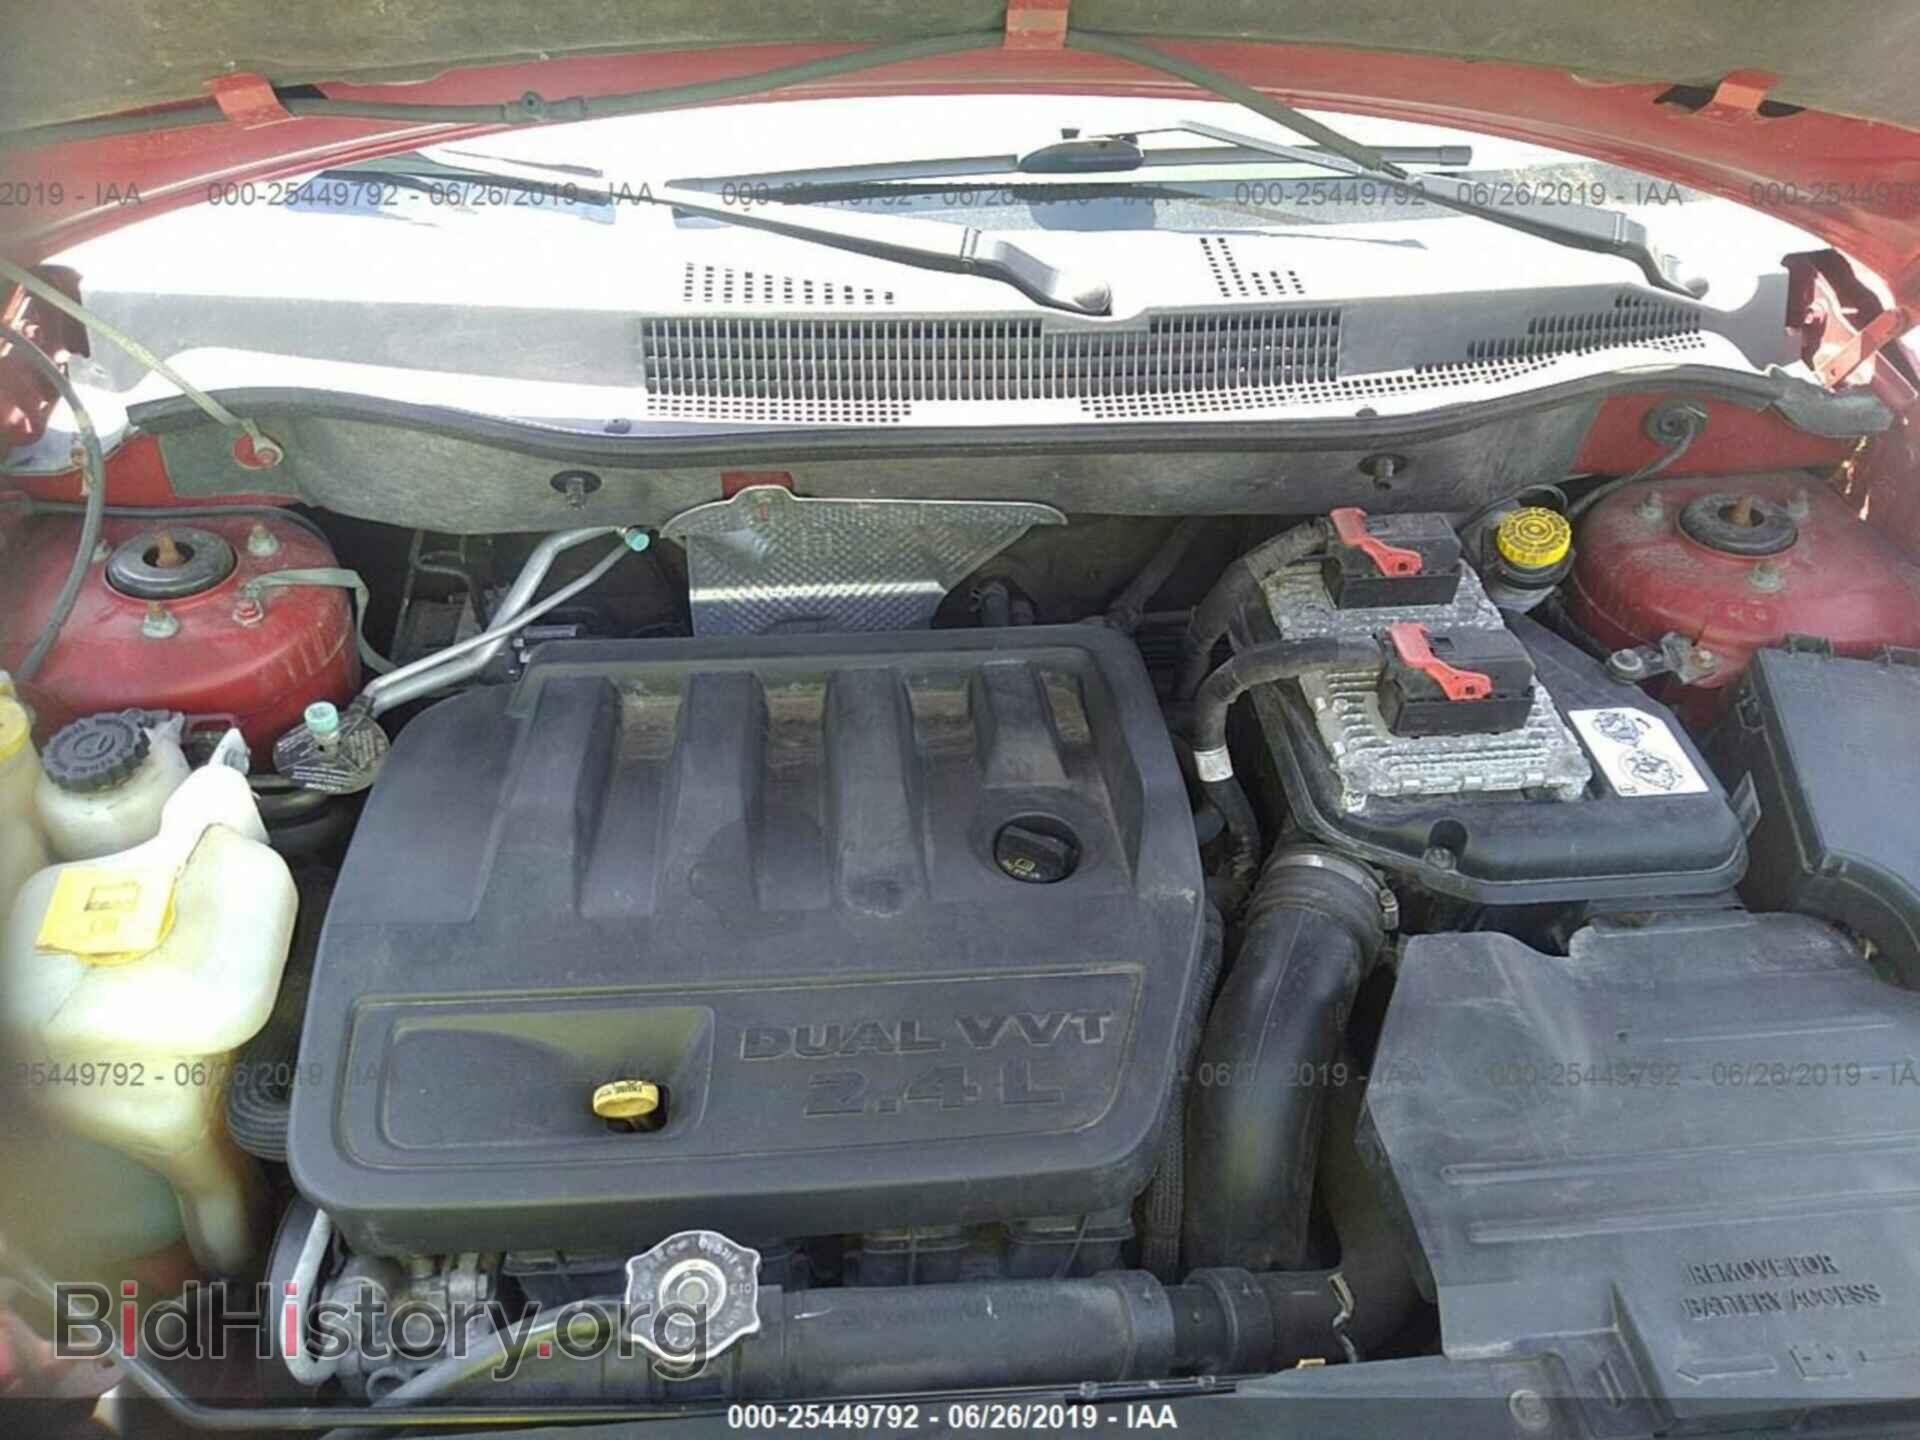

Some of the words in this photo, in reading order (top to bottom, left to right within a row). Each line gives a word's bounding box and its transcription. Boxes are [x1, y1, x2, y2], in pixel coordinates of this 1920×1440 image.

[740, 1019, 947, 1061] DUAL
[955, 1010, 1118, 1050] VVT
[802, 1057, 1066, 1119] 2.4L
[1688, 1255, 1789, 1285] REMOVE
[1786, 1249, 1841, 1279] FOR
[1681, 1290, 1784, 1320] BATTERY
[1789, 1281, 1884, 1312] ACCESS
